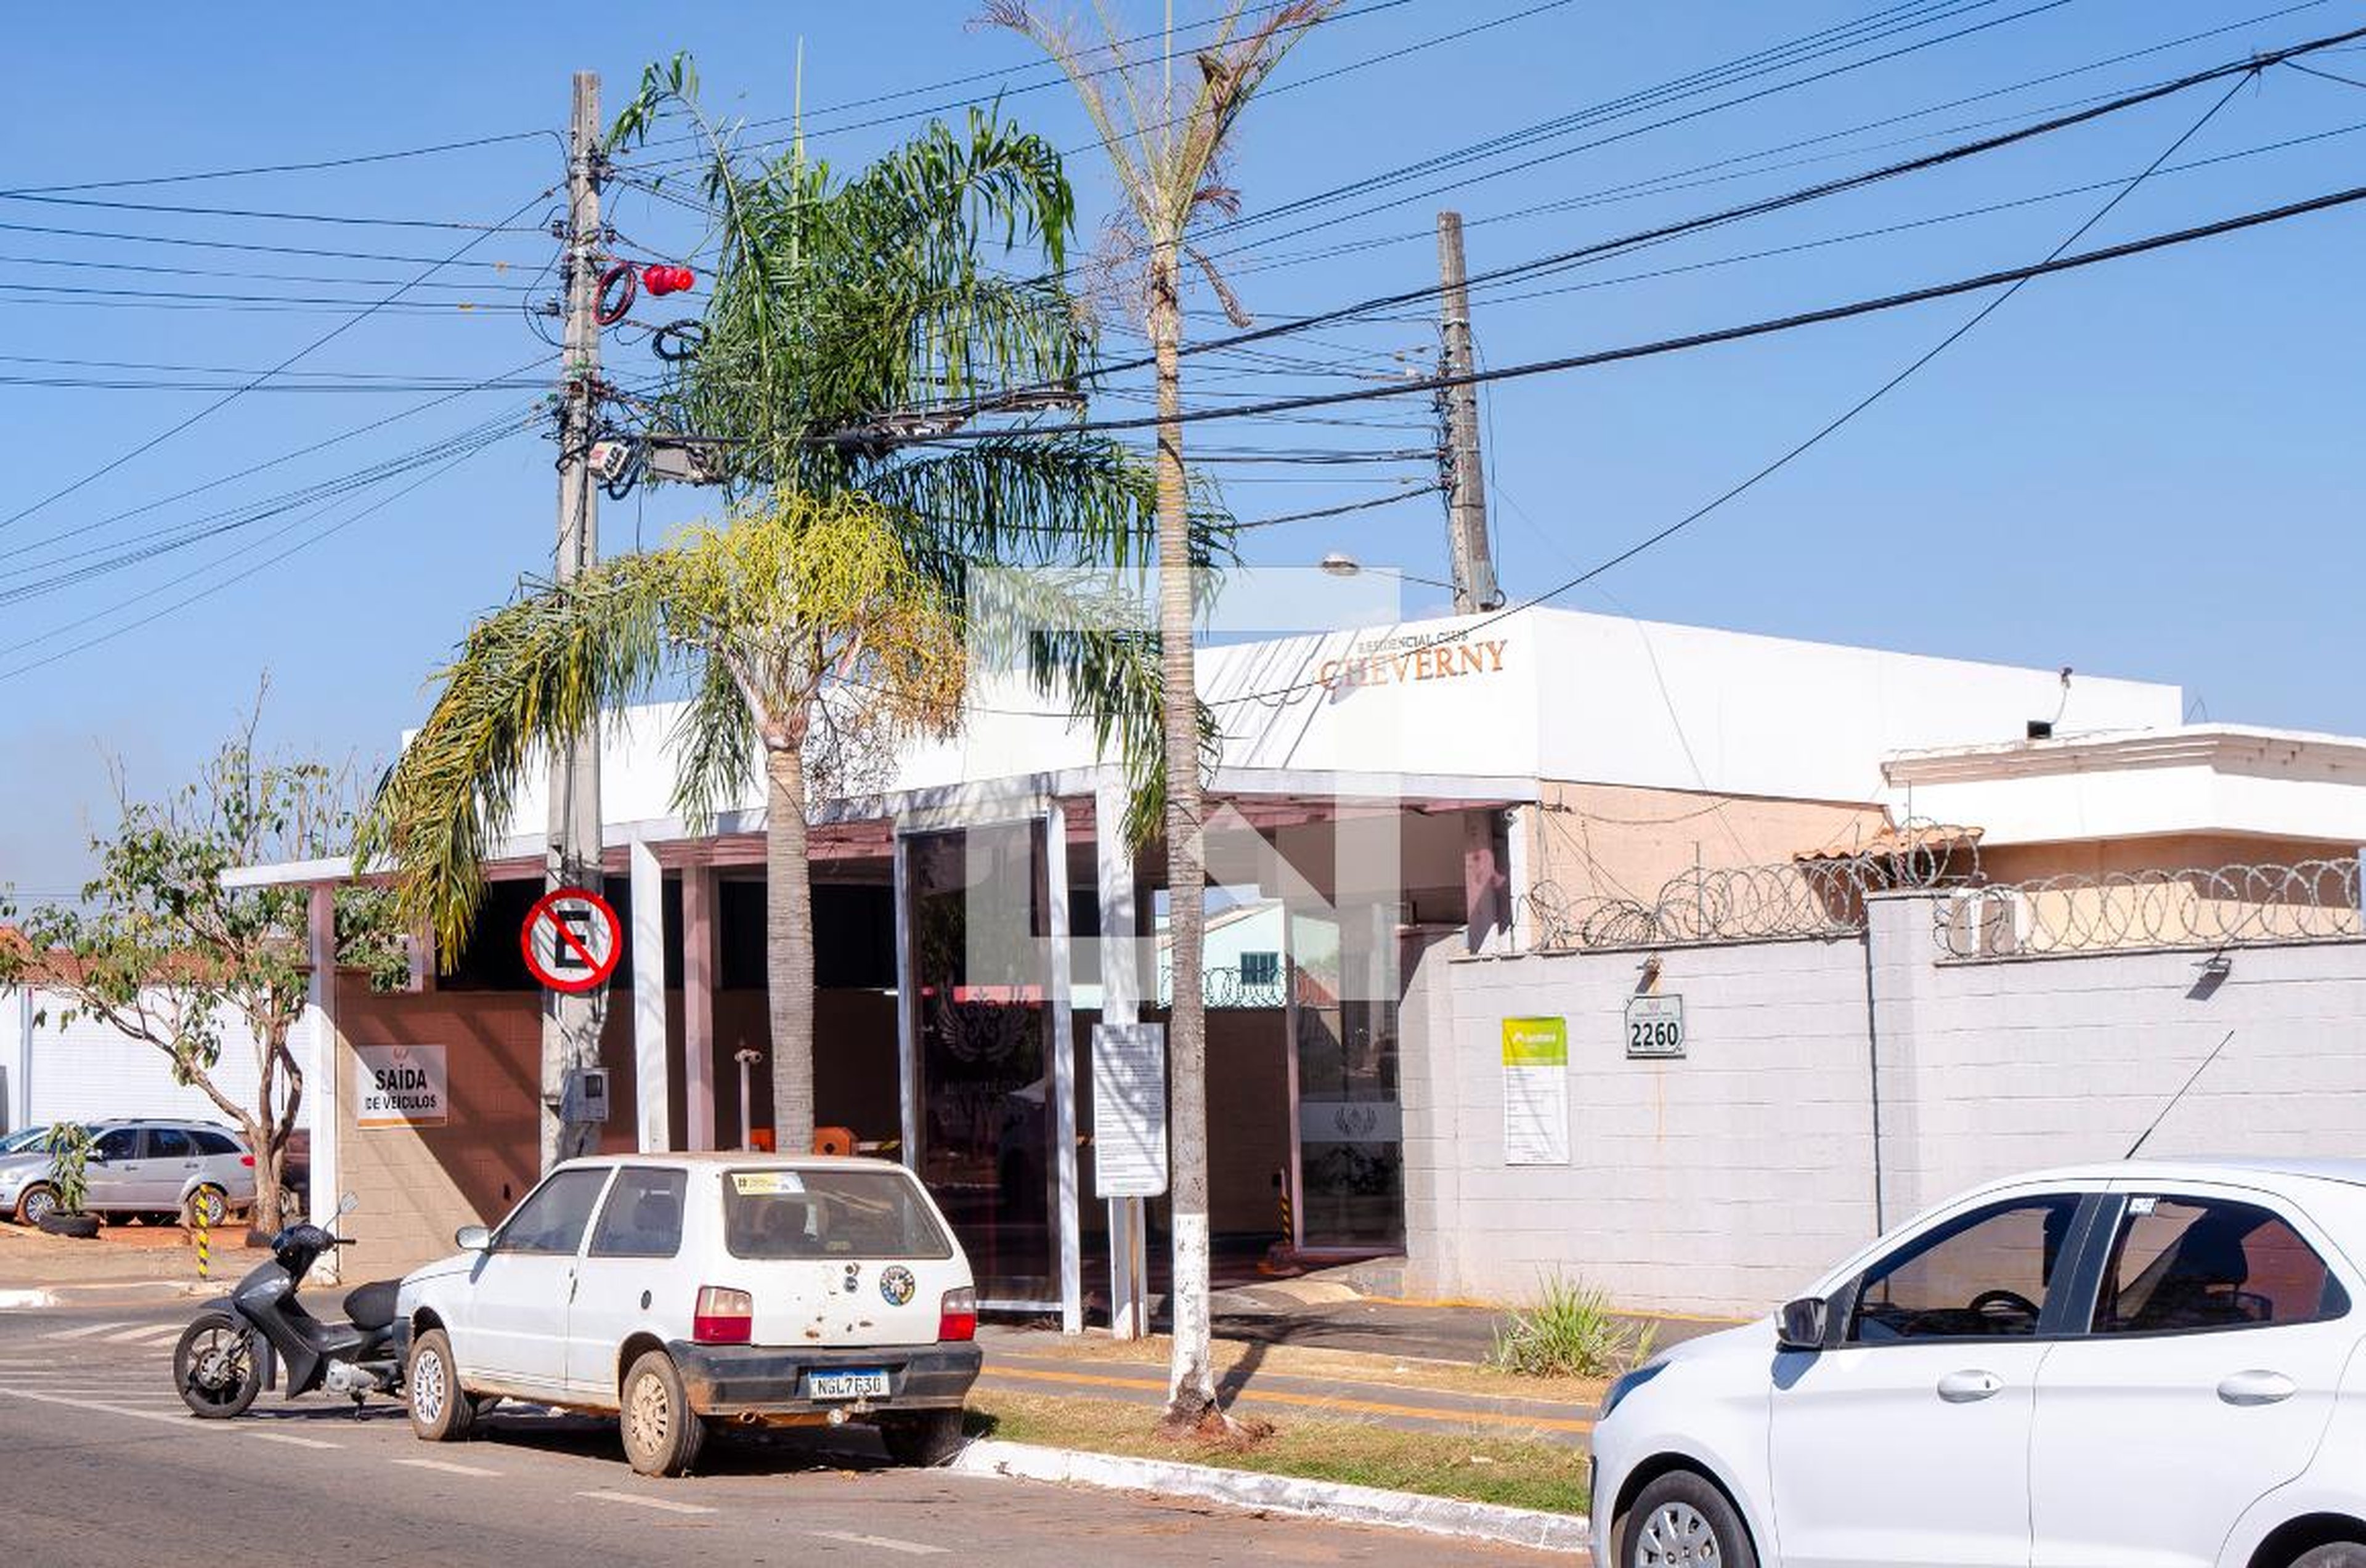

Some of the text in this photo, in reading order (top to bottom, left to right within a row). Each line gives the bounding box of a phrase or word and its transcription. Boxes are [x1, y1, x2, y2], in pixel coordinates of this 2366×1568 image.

[1357, 634, 1433, 654] RESIDENCIAL
[1319, 638, 1508, 689] CHEVERNY
[556, 909, 590, 968] E
[1630, 1022, 1679, 1047] 2260
[375, 1063, 428, 1091] SAÍDA
[366, 1097, 381, 1110] DE
